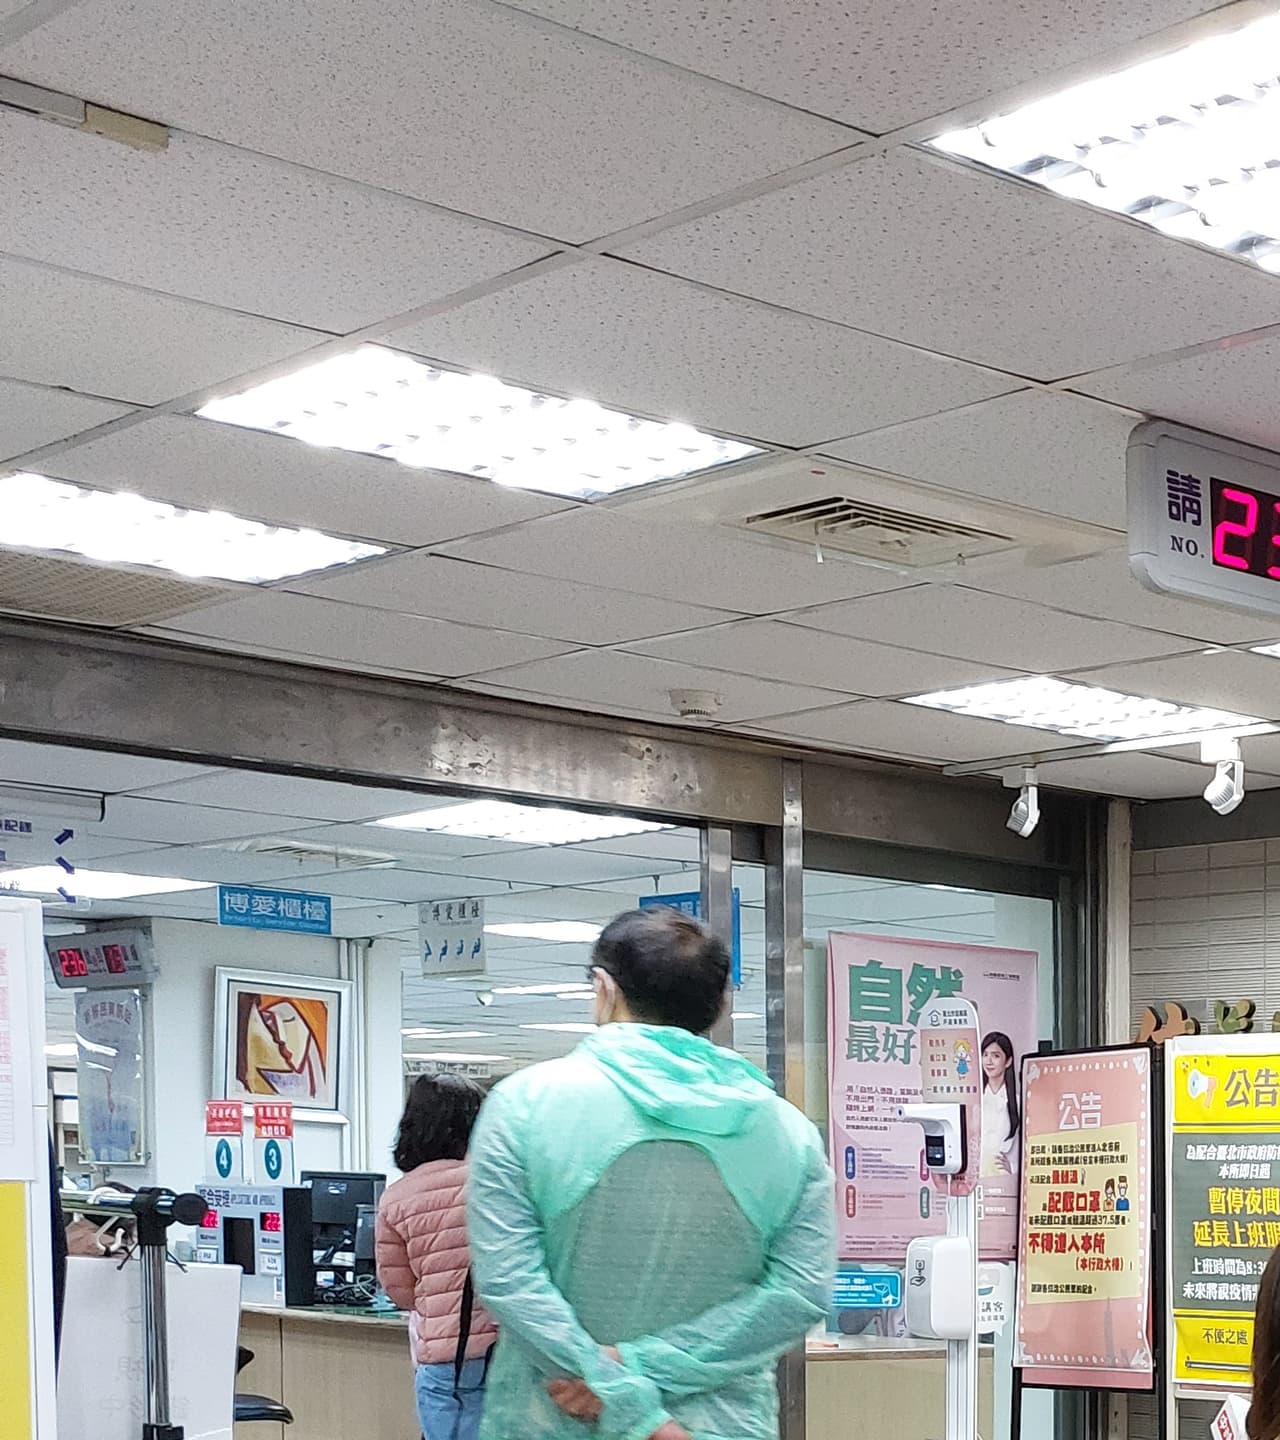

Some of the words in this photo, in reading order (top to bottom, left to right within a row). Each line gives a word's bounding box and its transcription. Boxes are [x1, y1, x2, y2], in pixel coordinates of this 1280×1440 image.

[1167, 469, 1202, 527] 請
[1169, 534, 1205, 560] NO.
[222, 892, 327, 921] 博愛櫃檯
[848, 959, 964, 1026] 自然
[845, 1023, 918, 1066] 最好
[1224, 1068, 1280, 1108] 公告
[1058, 1091, 1102, 1130] 公告
[219, 1147, 229, 1170] 4
[268, 1148, 278, 1171] 3
[1218, 1162, 1272, 1180] 本所即日起
[1208, 1186, 1280, 1216] 暫停夜間
[1028, 1231, 1106, 1255] 不得進入本所
[1202, 1327, 1249, 1345] 不便之處
